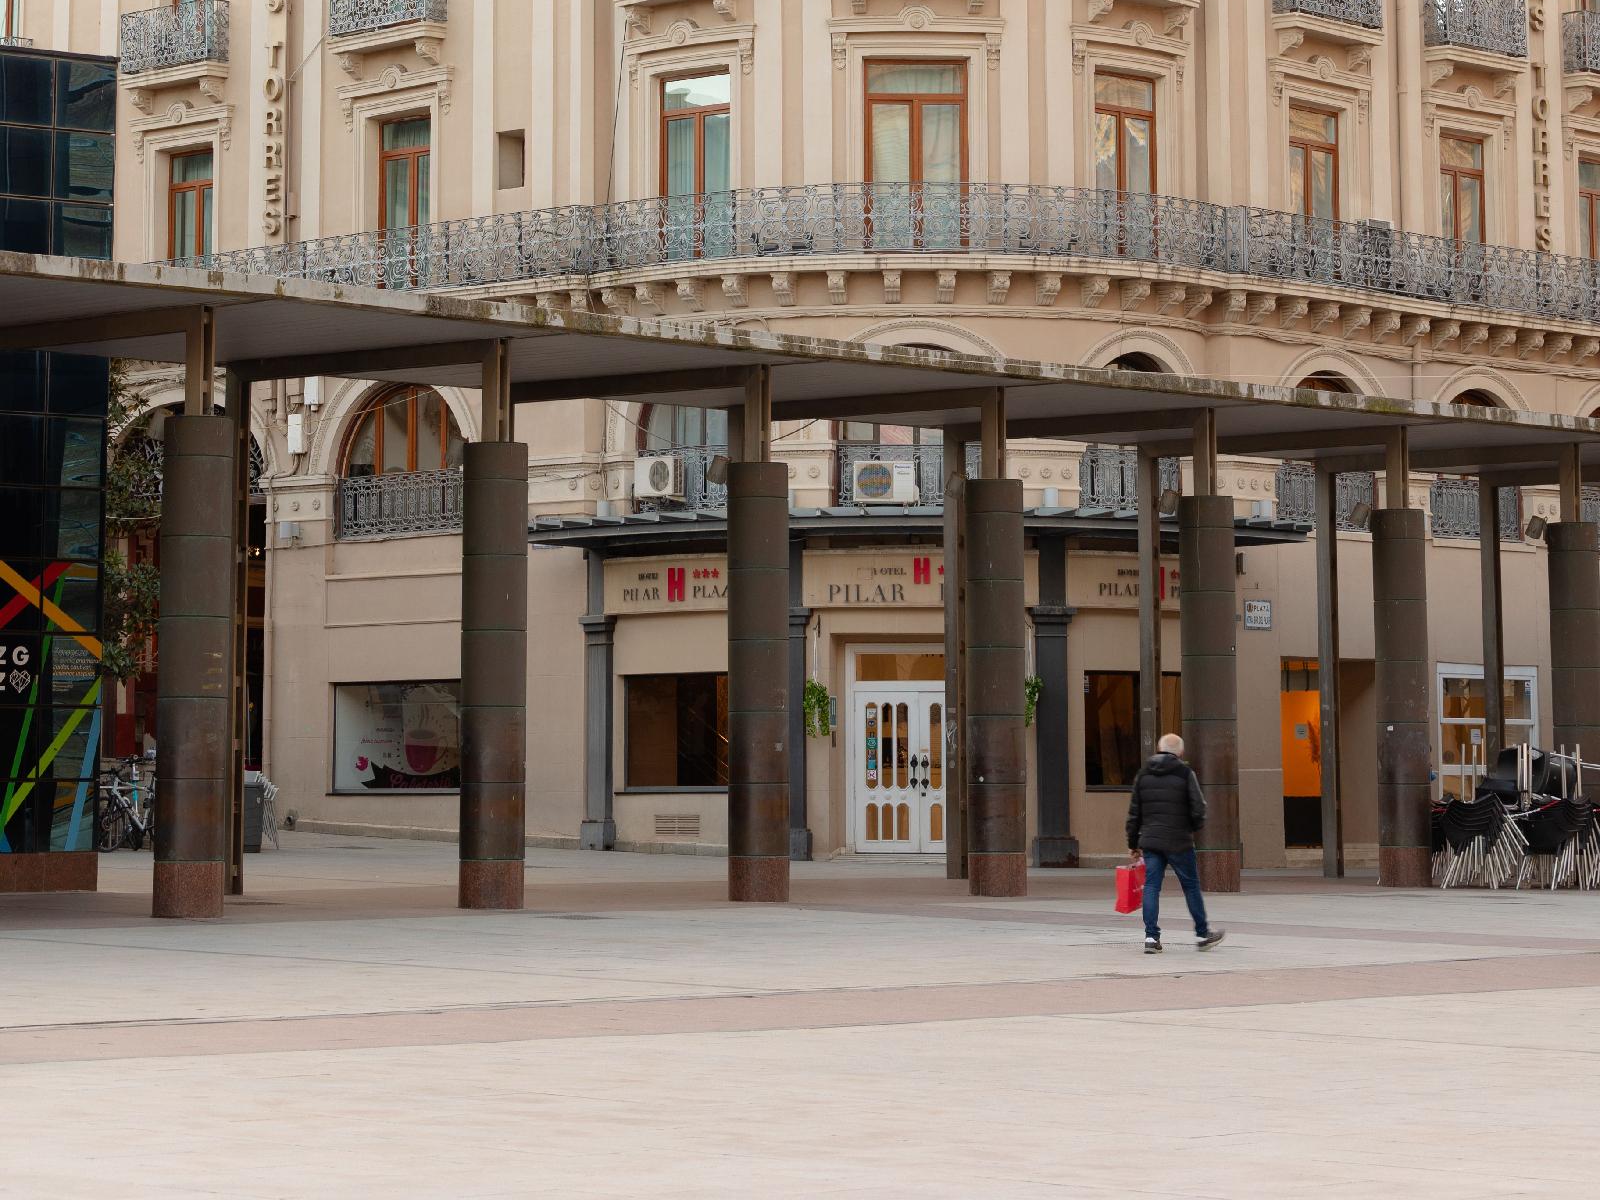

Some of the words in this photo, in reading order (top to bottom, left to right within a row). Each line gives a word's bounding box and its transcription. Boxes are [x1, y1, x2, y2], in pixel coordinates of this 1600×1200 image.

[262, 41, 284, 236] TORRES
[1531, 62, 1553, 251] TORRES
[623, 587, 660, 601] PILAR
[828, 583, 905, 603] PILAR
